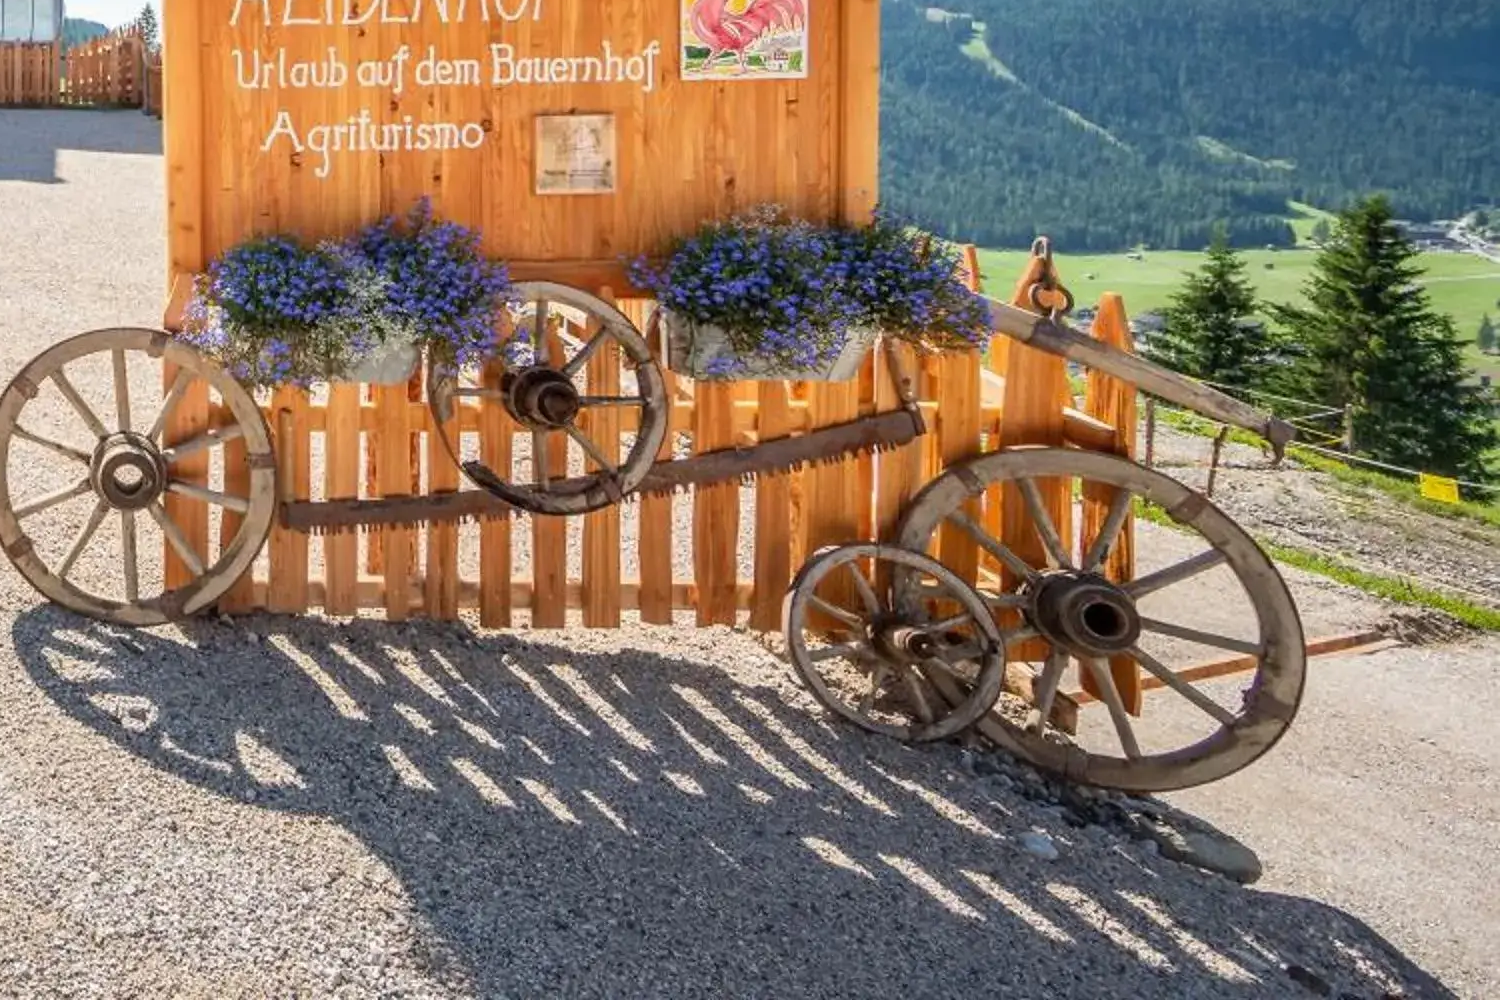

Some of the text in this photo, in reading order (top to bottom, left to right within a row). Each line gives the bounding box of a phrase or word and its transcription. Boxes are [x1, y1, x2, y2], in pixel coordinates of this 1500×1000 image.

[232, 41, 660, 93] Urlaub auf dem Bauernhof
[260, 107, 485, 178] Agriturismo
